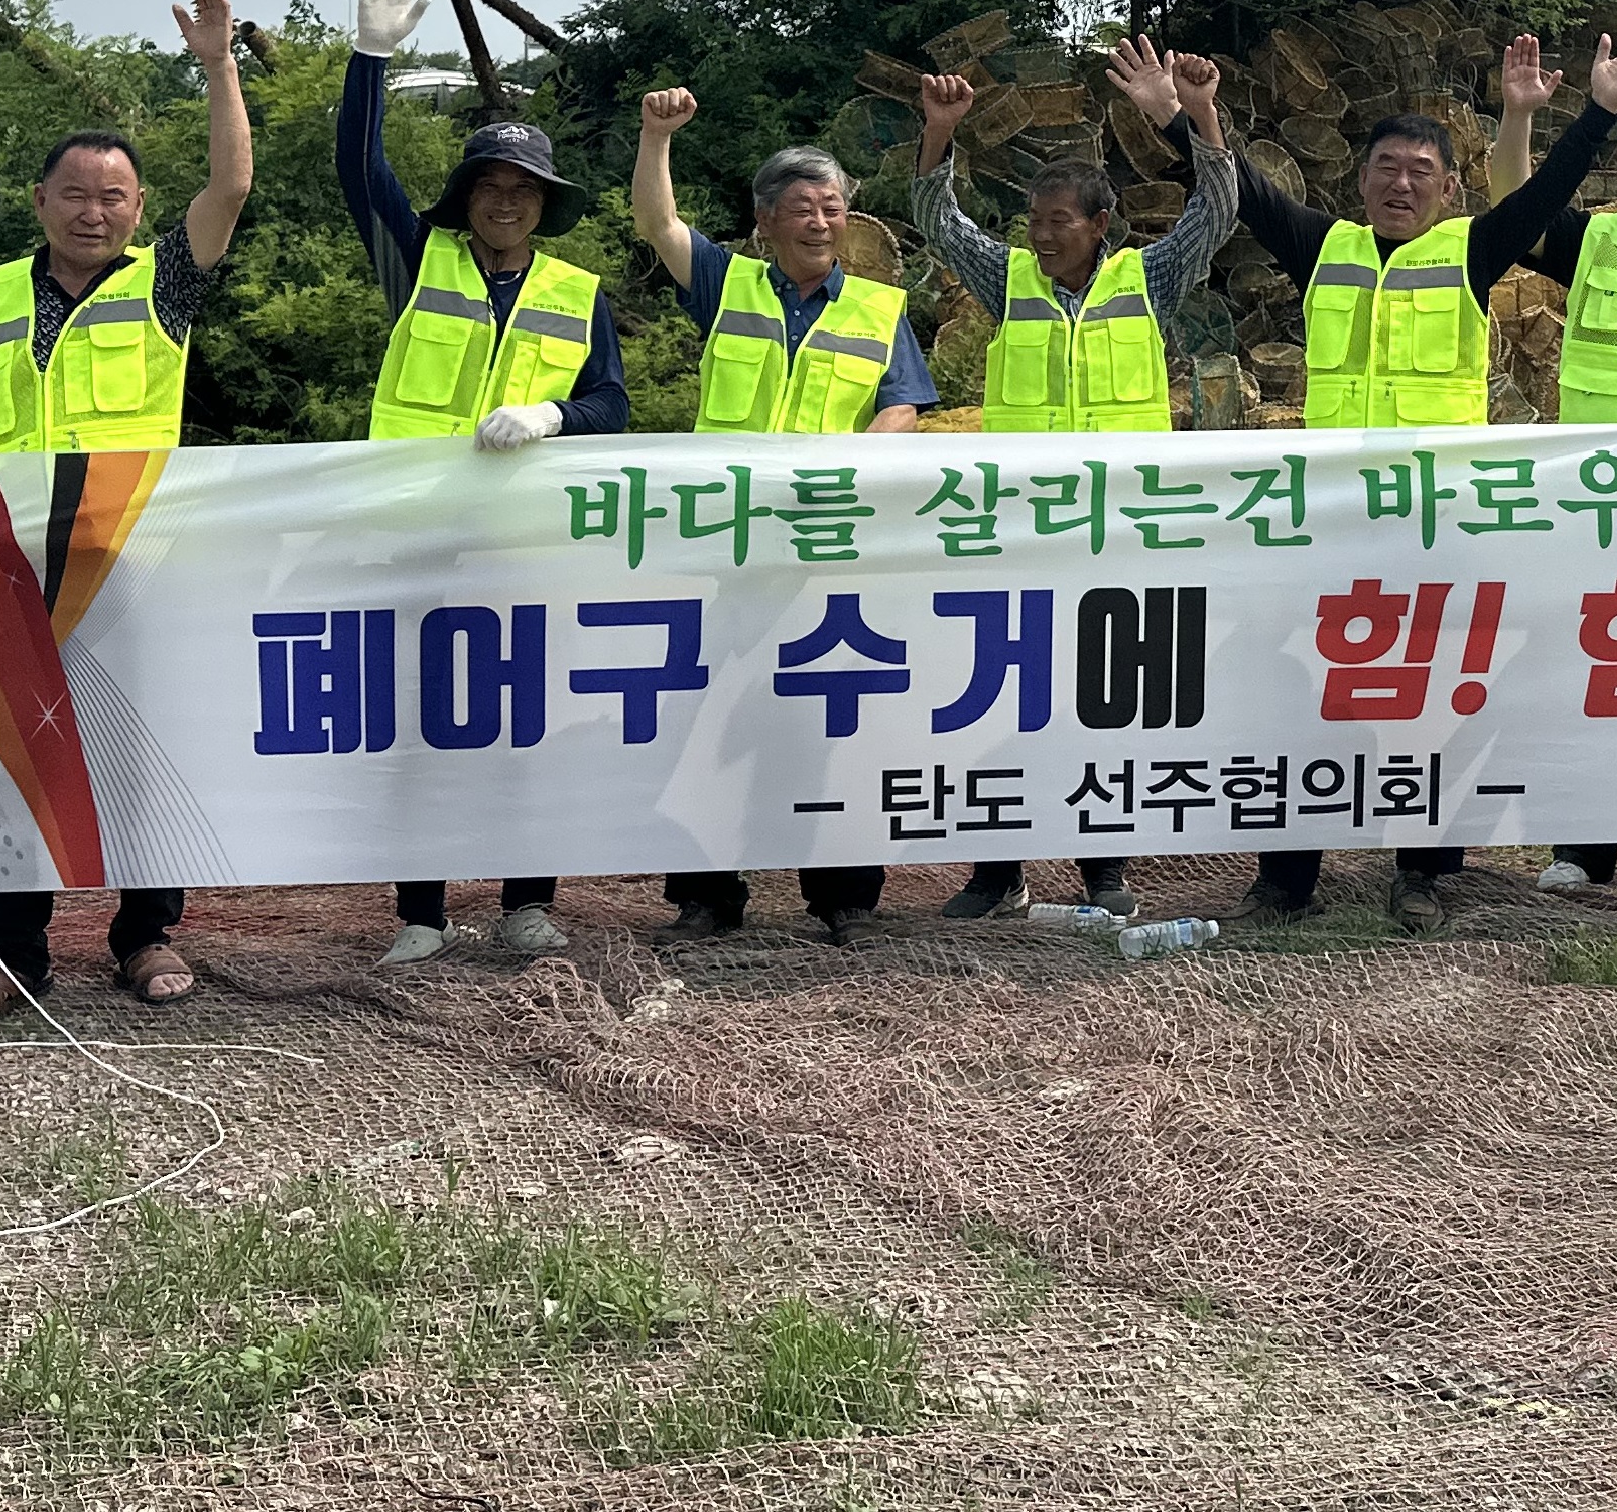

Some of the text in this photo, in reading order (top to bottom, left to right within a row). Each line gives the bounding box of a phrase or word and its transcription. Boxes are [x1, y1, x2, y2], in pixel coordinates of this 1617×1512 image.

[567, 465, 876, 569] 바다를
[915, 454, 1313, 557] 살리는건
[251, 597, 710, 757] 폐어구
[772, 587, 1206, 738] 수거에
[1315, 578, 1506, 723] 힘!
[880, 765, 1034, 842] 탄도
[1065, 753, 1443, 834] 선주협의회
